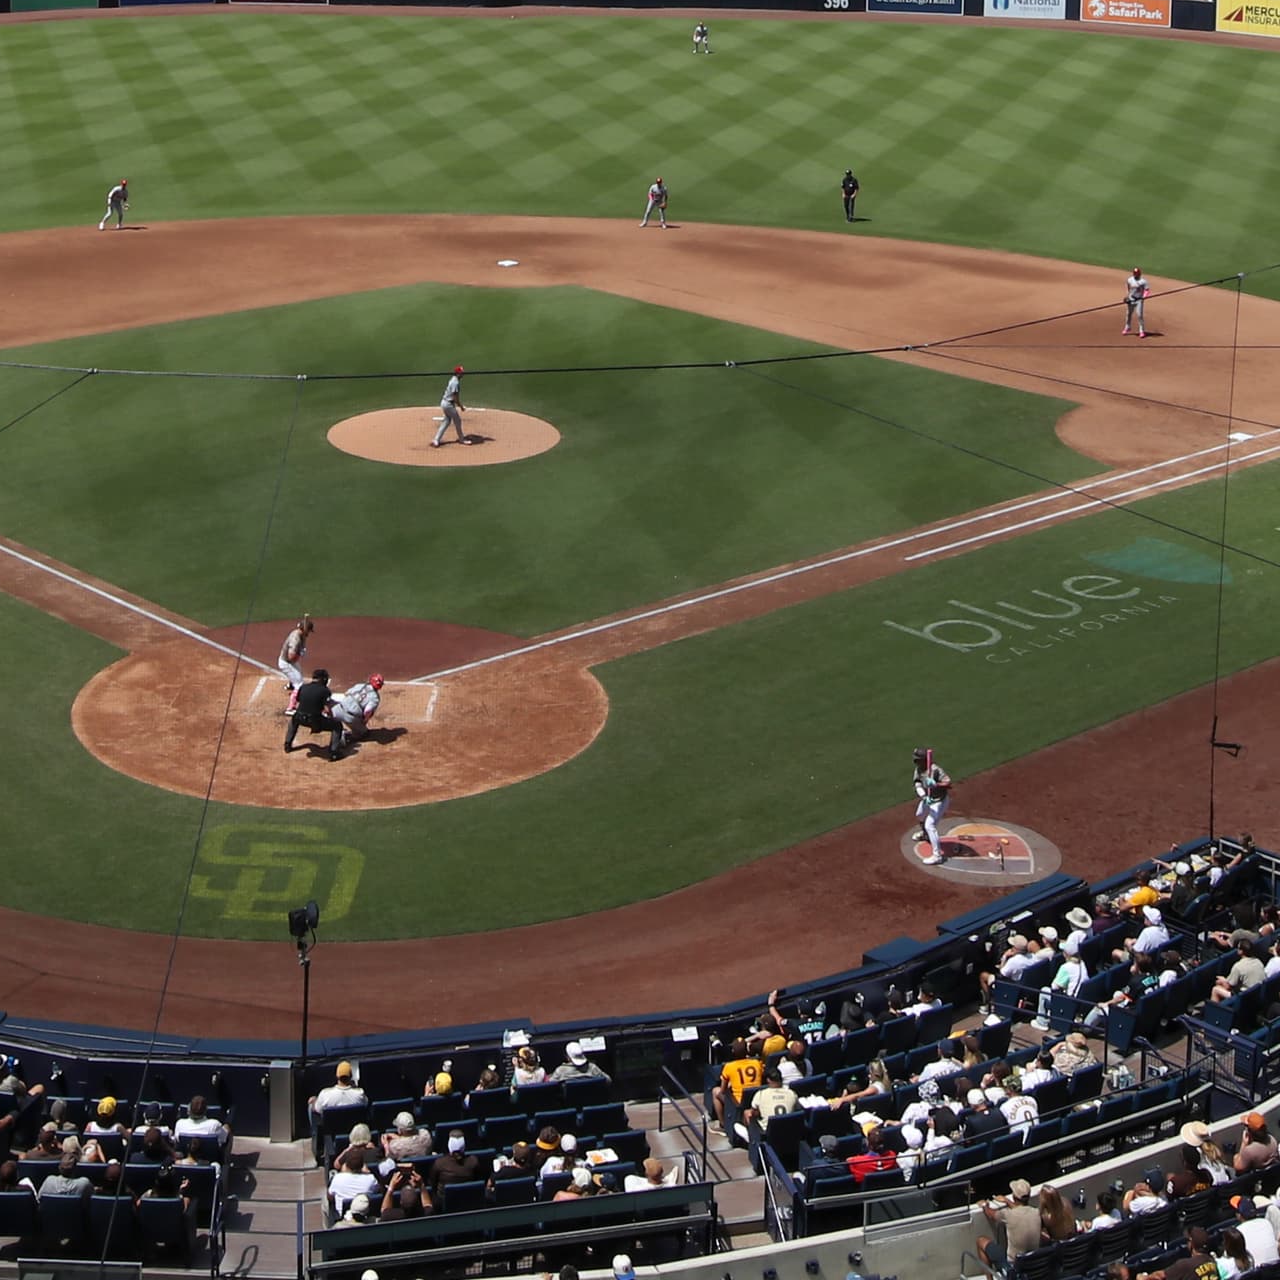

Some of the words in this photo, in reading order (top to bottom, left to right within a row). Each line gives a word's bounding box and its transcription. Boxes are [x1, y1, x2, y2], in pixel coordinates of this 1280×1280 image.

[1108, 7, 1137, 18] Safari
[1141, 9, 1163, 20] Park
[883, 574, 1141, 653] blue
[986, 593, 1180, 665] CALIFORNIA
[737, 1066, 756, 1084] 19
